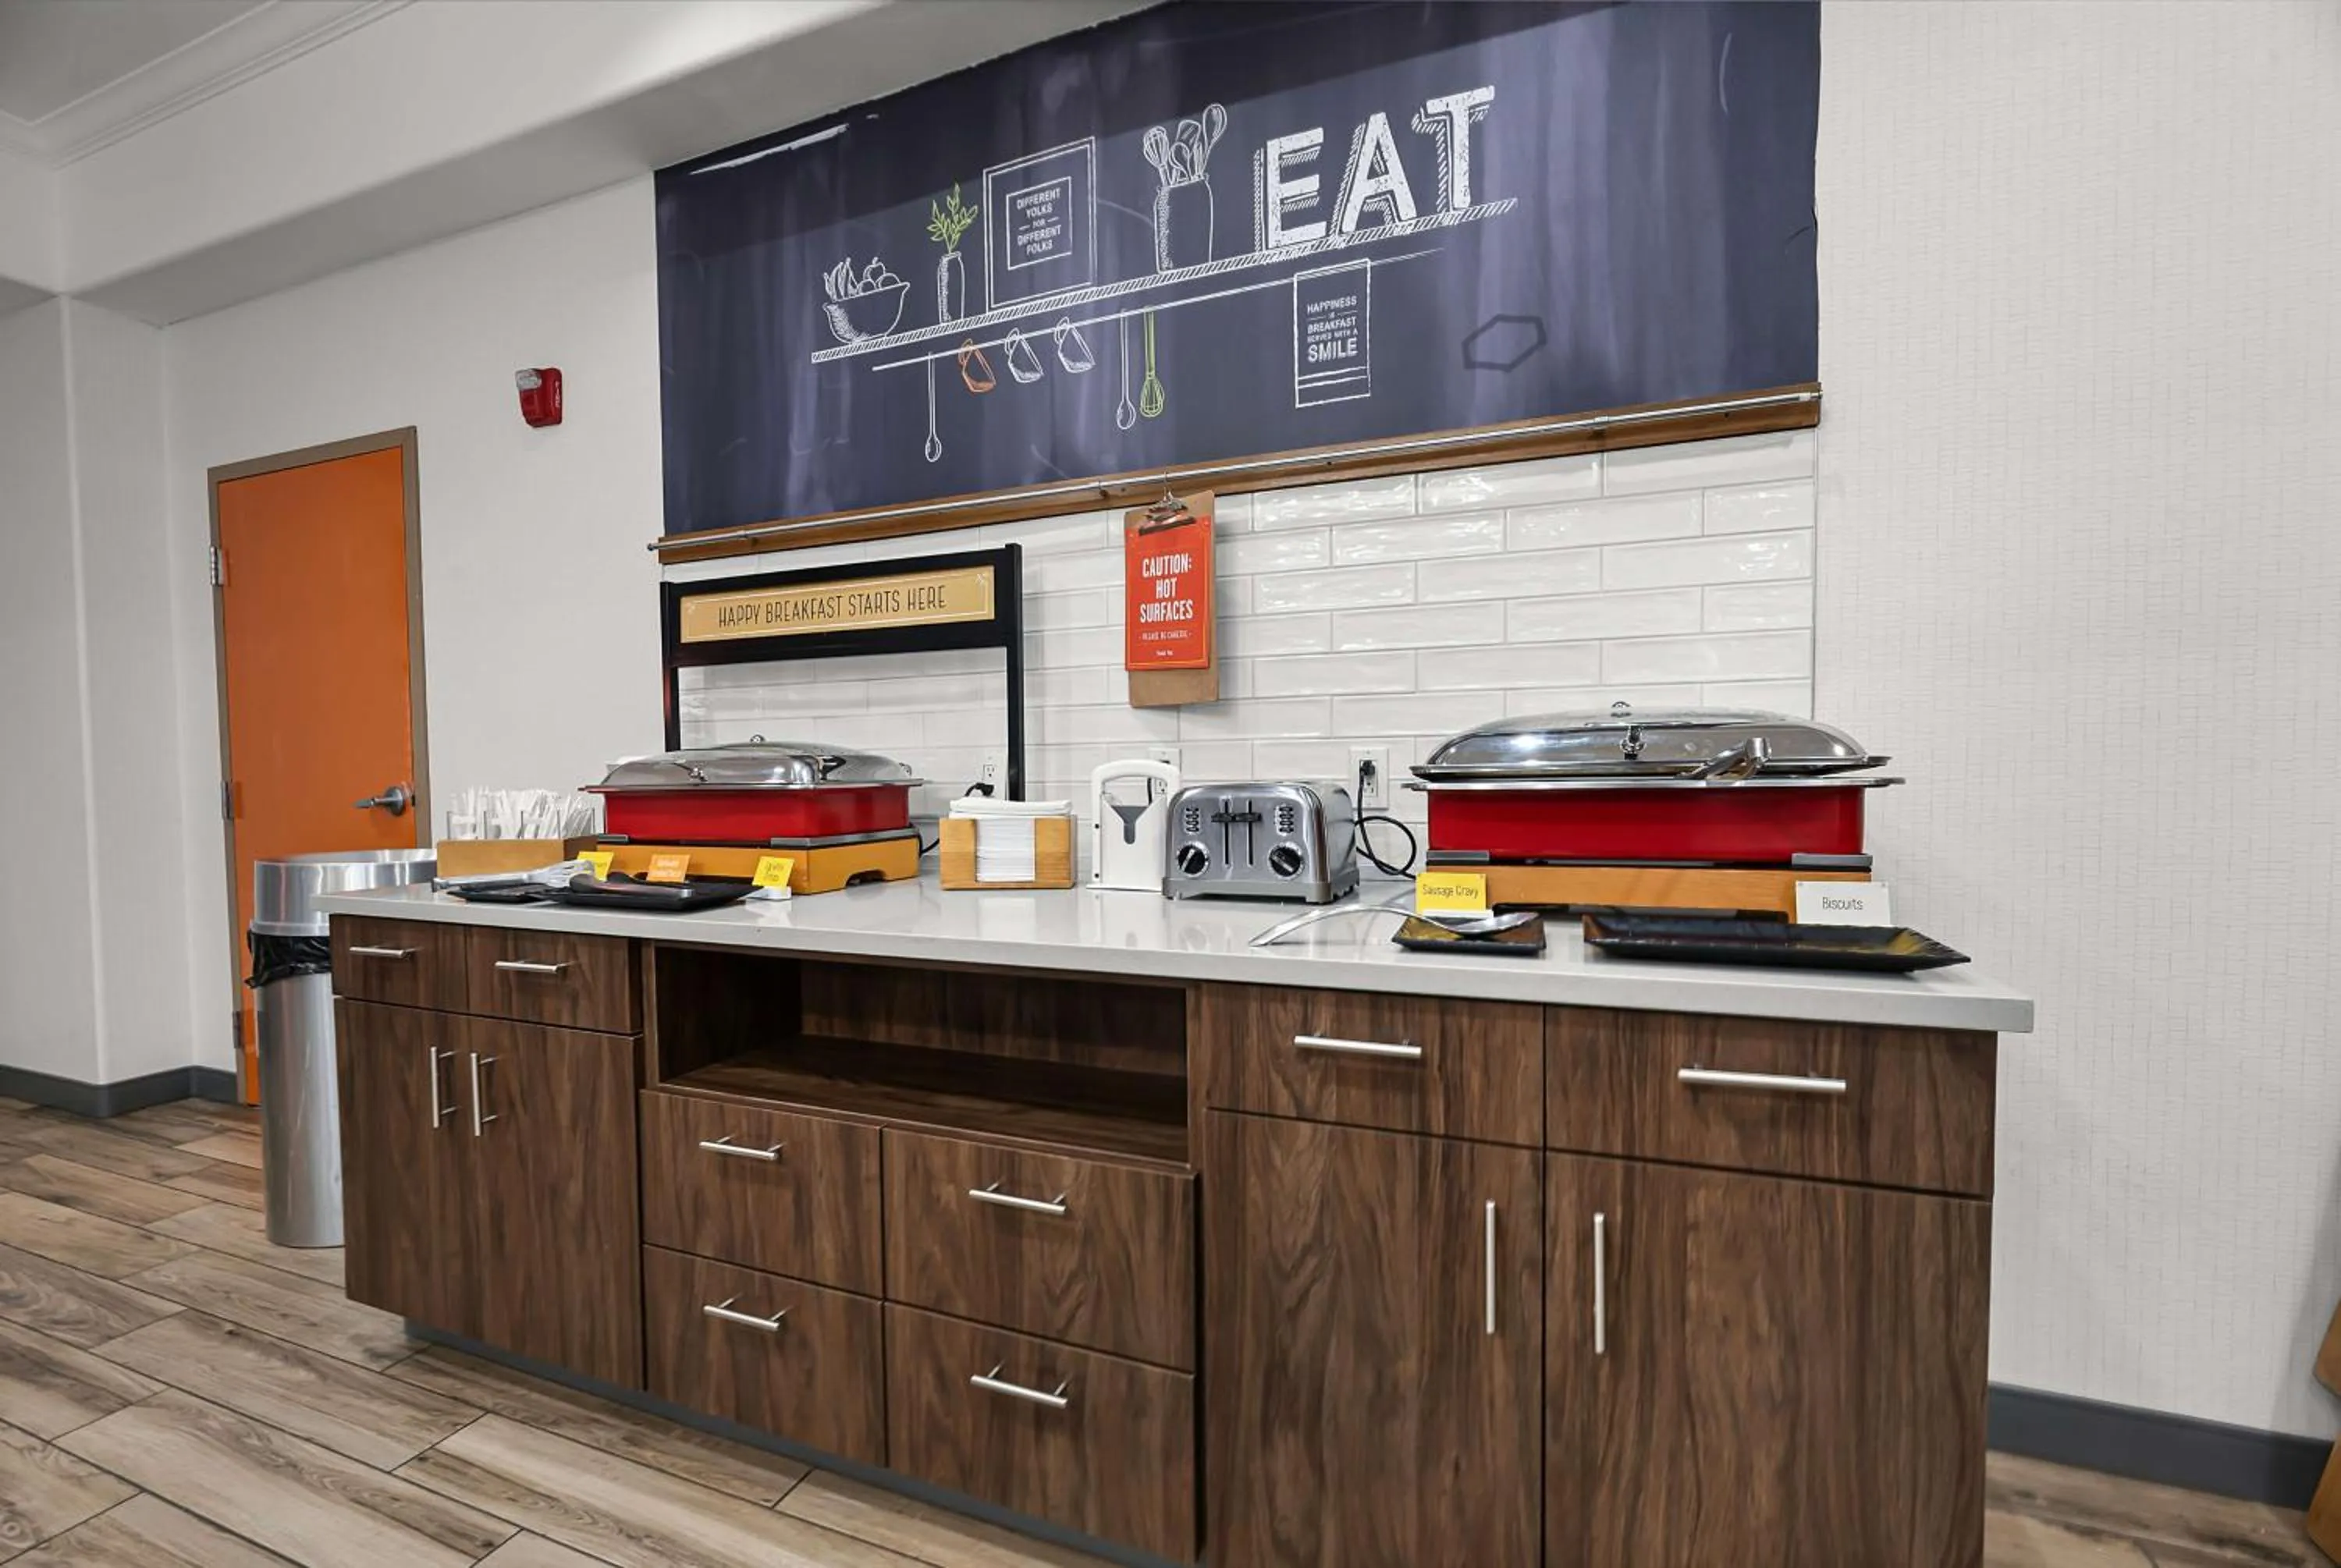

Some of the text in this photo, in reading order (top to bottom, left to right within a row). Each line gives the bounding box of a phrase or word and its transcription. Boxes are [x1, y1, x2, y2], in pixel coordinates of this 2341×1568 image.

[1253, 85, 1495, 251] EAT
[1017, 188, 1061, 210] DIFFERENT
[1026, 202, 1053, 218] YOLKS
[1018, 224, 1062, 247] DIFFERENT
[1026, 239, 1053, 256] FOLKS
[1307, 296, 1358, 315] HAPPINESS
[1307, 317, 1357, 334] BREAKFAST
[1307, 338, 1359, 364] SMILE
[1142, 552, 1192, 578] CAUTION:
[1155, 578, 1178, 600] HOT
[718, 585, 947, 627] HAPPY BREAKFAST STARTS HERE
[1139, 600, 1193, 624] SURFACES
[1822, 896, 1864, 910] Biscuits
